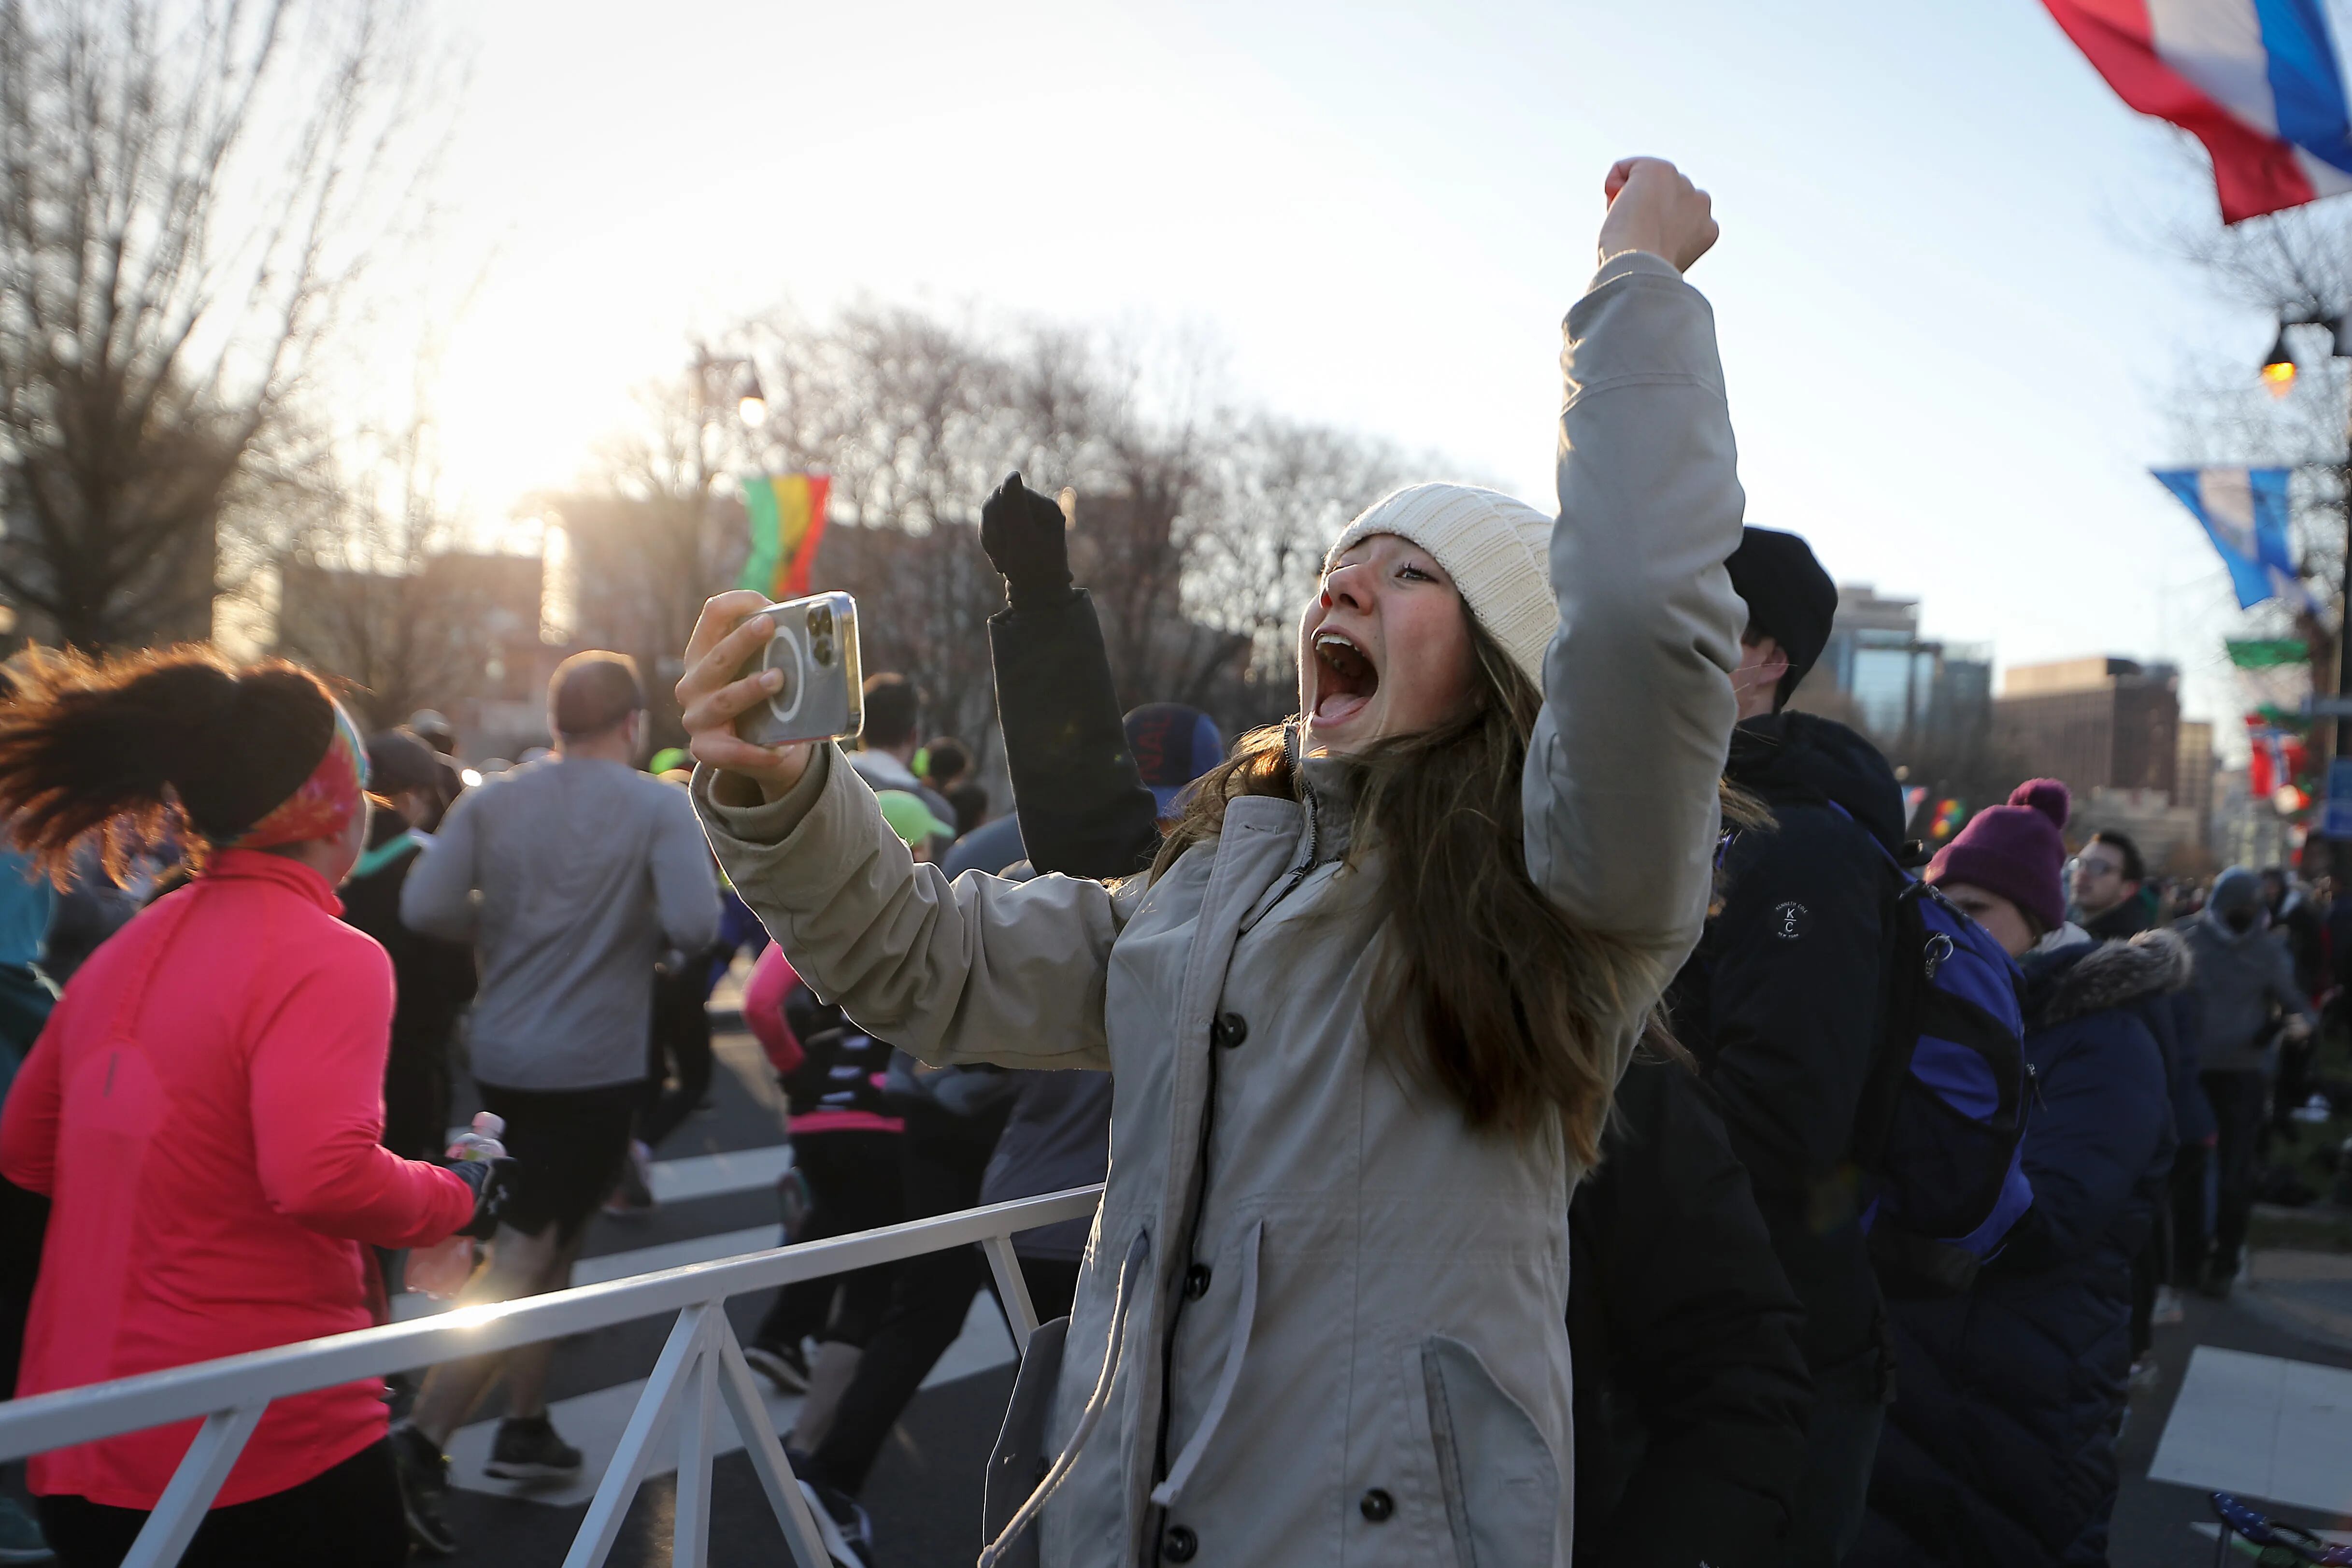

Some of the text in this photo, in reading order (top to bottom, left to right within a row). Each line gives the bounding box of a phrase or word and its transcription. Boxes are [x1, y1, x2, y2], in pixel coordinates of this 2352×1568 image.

[1776, 901, 1808, 913] KENNETH COLE
[1787, 908, 1795, 918] K
[1785, 922, 1794, 932] C
